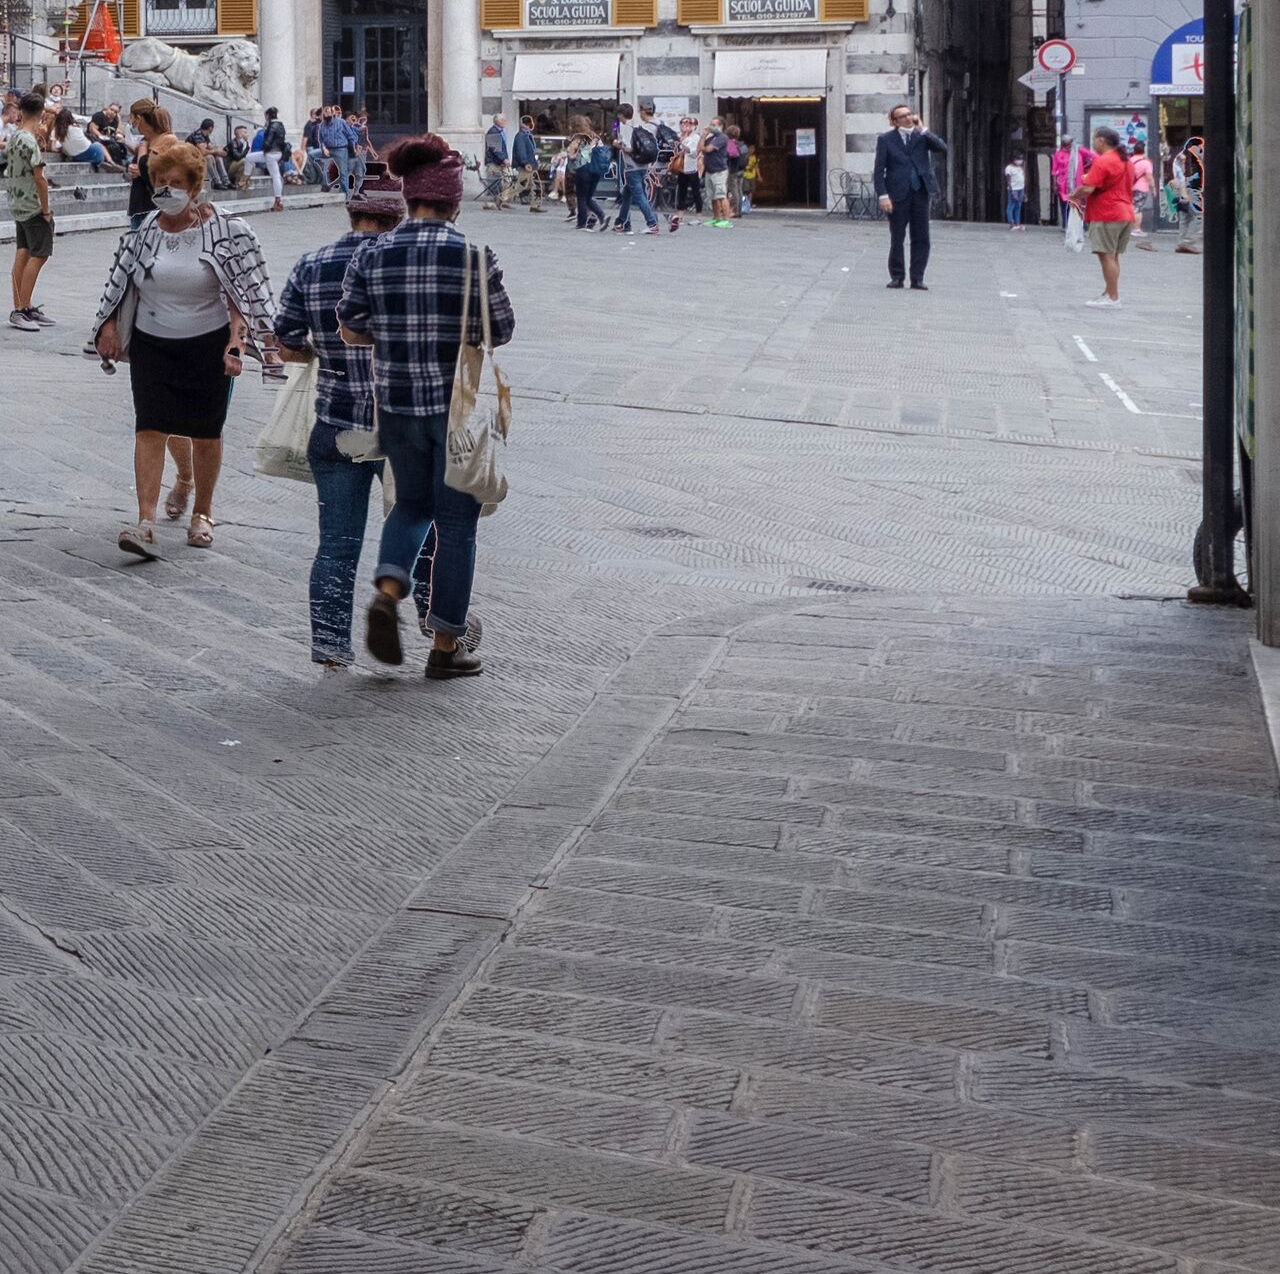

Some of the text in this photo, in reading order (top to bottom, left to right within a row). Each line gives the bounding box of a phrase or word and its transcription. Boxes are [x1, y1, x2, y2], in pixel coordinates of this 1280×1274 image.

[530, 5, 606, 19] SCUOLA GUIDA
[730, 0, 773, 14] SCUOLA
[1185, 35, 1204, 43] TOU
